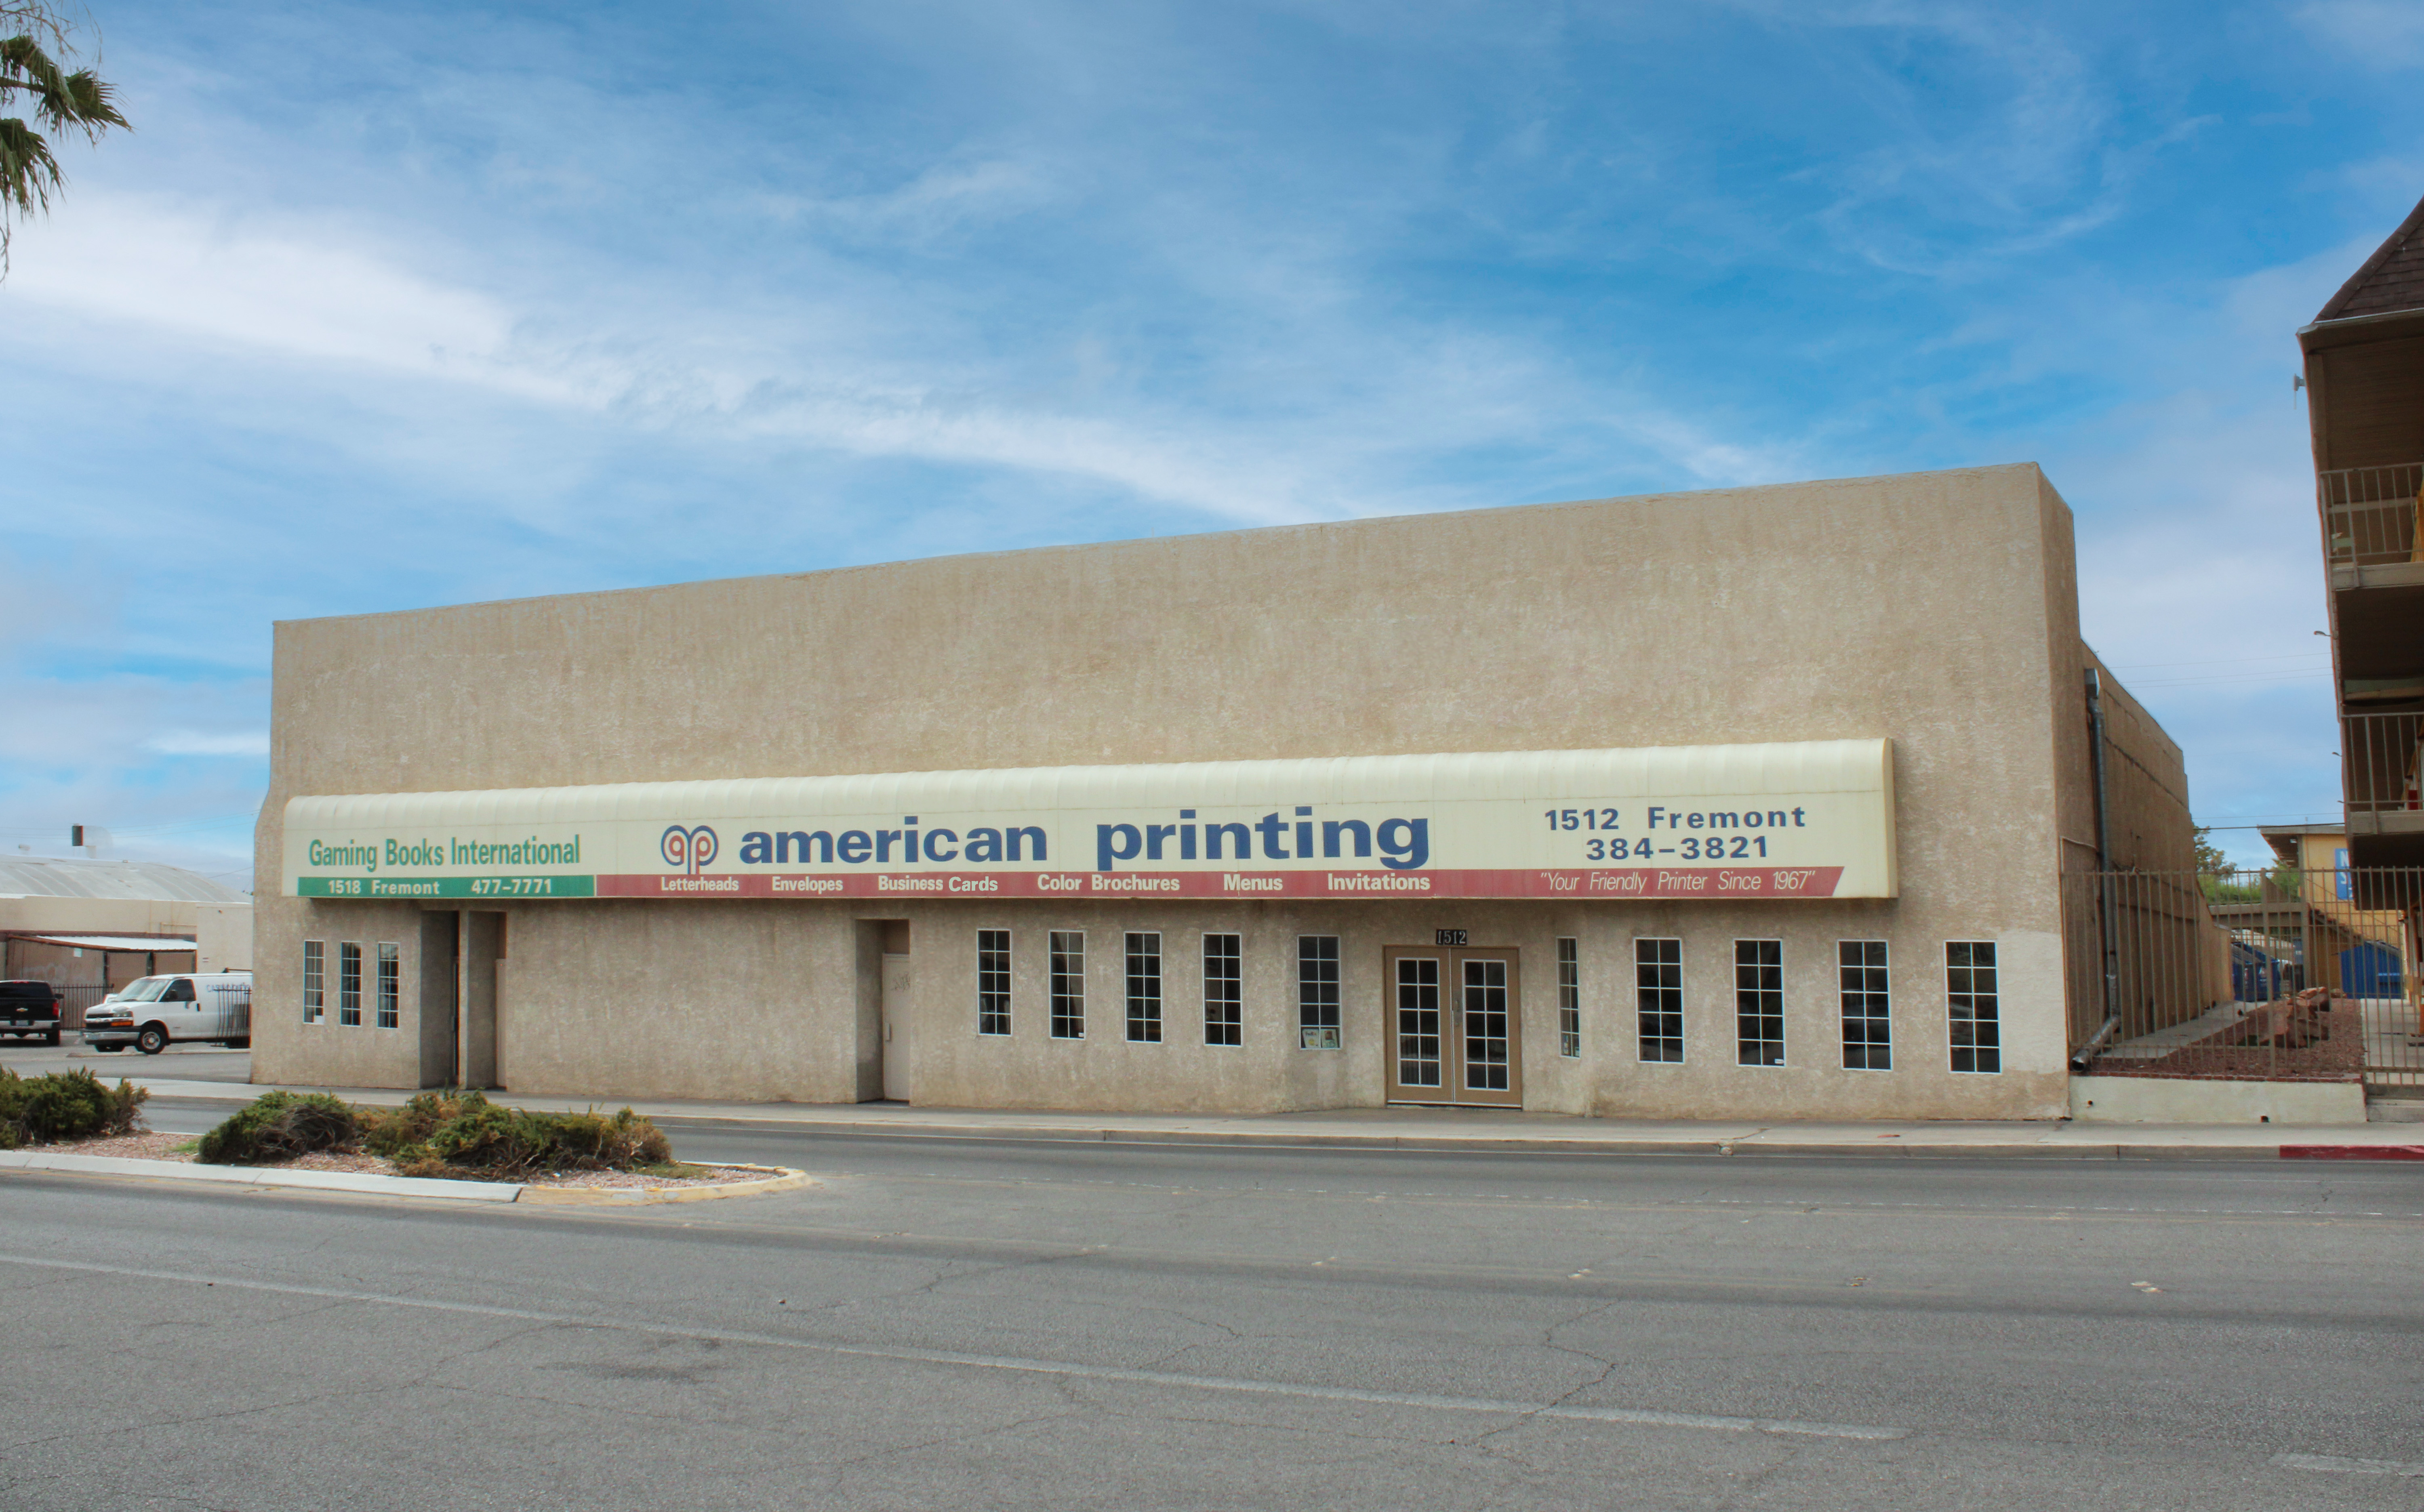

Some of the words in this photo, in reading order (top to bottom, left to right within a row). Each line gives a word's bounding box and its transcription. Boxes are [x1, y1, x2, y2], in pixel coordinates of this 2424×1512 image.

[1544, 808, 1620, 831] 1512
[1648, 807, 1806, 829] Fremont
[739, 816, 1047, 863] american
[1096, 806, 1429, 871] printing
[308, 839, 378, 873] Gaming
[385, 838, 444, 866] Books
[450, 834, 580, 865] International
[1586, 836, 1767, 860] 384-3821
[328, 879, 362, 894] 1518
[371, 879, 440, 895] Fremont
[471, 878, 552, 894] 477-7771
[661, 876, 739, 891] Letterheads
[772, 876, 844, 894] Envelopes
[878, 875, 944, 891] Business
[948, 875, 998, 892] Cards
[1037, 874, 1082, 891] Color
[1091, 874, 1180, 891] Brochures
[1224, 874, 1283, 891] Menus
[1328, 873, 1431, 891] Invitations
[1540, 871, 1580, 891] "Your
[1589, 871, 1647, 894] Friendly
[1657, 871, 1708, 890] Printer
[1717, 871, 1761, 890] Since
[1772, 870, 1816, 890] 1967"
[1438, 931, 1466, 944] 1512
